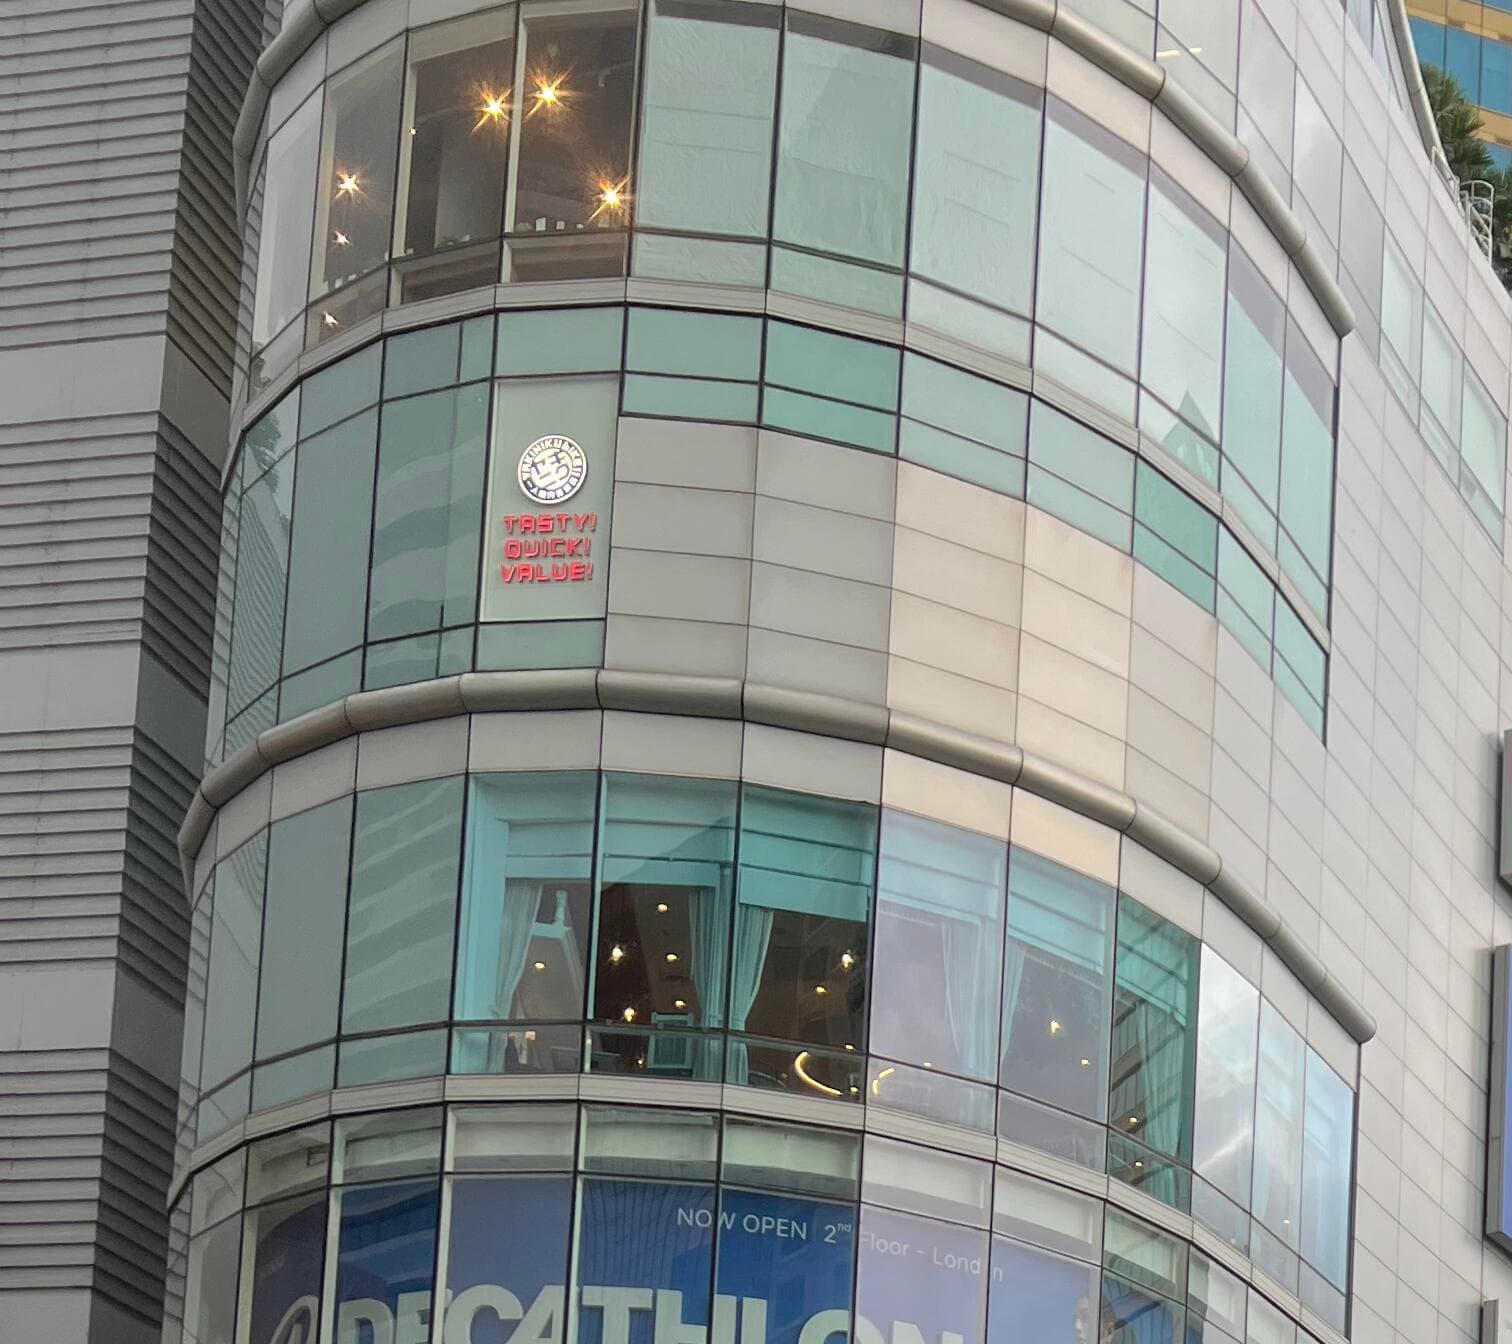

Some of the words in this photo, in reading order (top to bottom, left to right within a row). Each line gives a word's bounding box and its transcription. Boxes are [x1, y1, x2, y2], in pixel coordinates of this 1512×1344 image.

[503, 512, 597, 533] TASTY!
[503, 537, 592, 559] QUICK!
[500, 561, 594, 582] VALUE!
[677, 1207, 736, 1231] NOW
[743, 1213, 807, 1240] OPEN
[859, 1229, 910, 1257] Floor
[933, 1246, 1003, 1282] Londn
